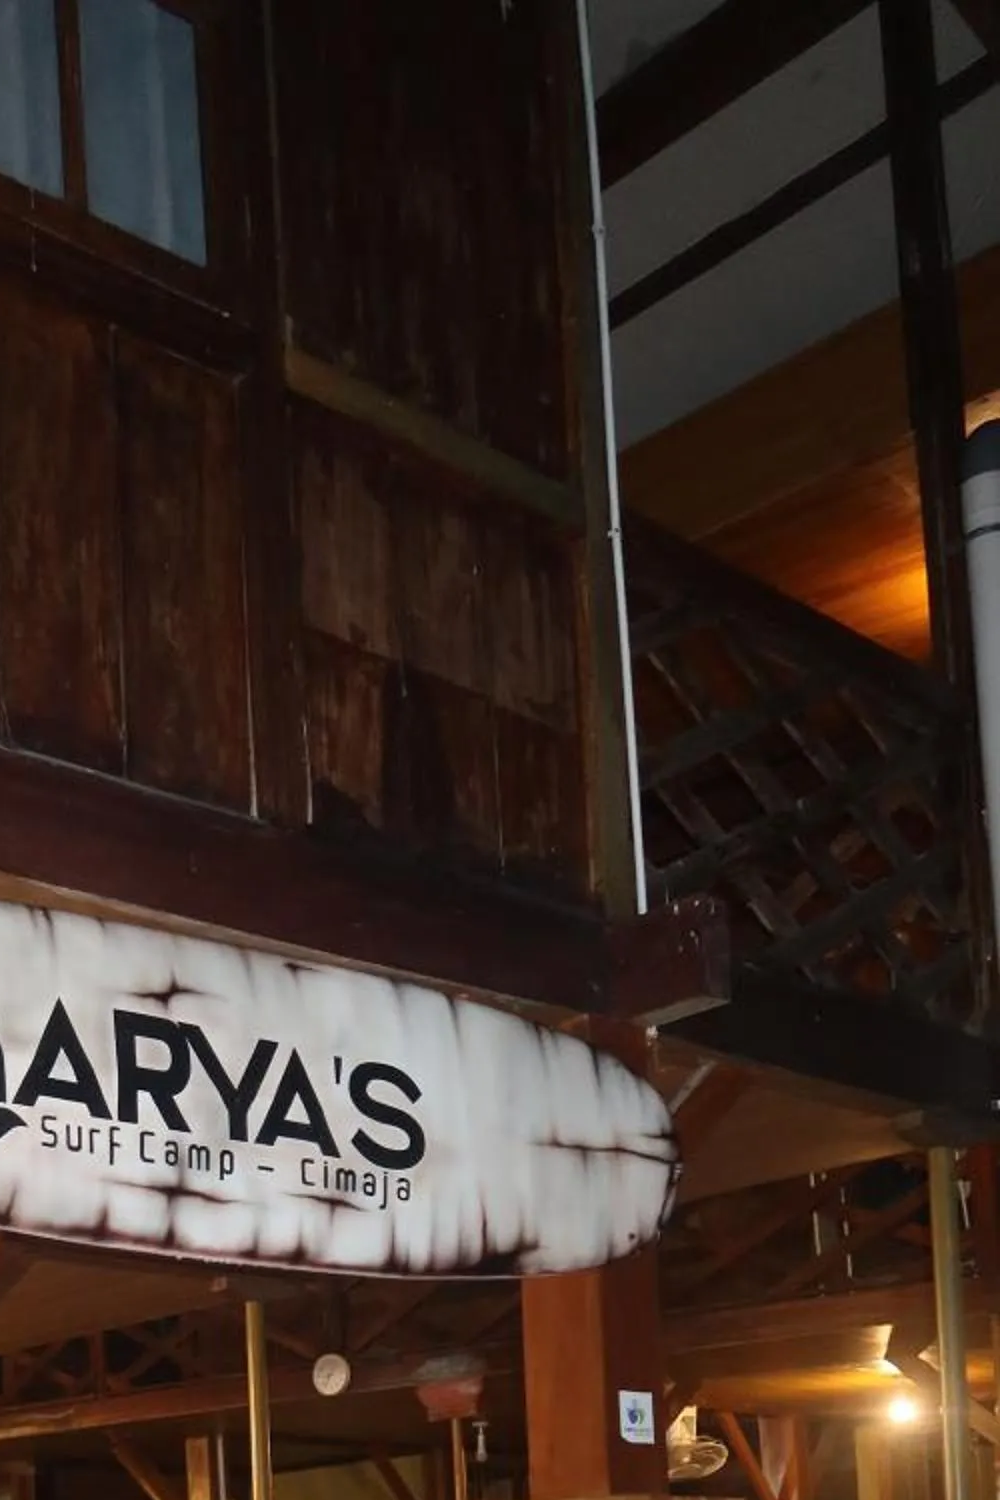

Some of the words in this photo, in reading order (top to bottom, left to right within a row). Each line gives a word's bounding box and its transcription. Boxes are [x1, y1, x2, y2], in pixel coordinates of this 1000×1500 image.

[12, 996, 427, 1170] ARYA'S
[40, 1115, 122, 1166] Surf
[139, 1131, 235, 1181] Camp
[300, 1157, 412, 1210] Cimaja
